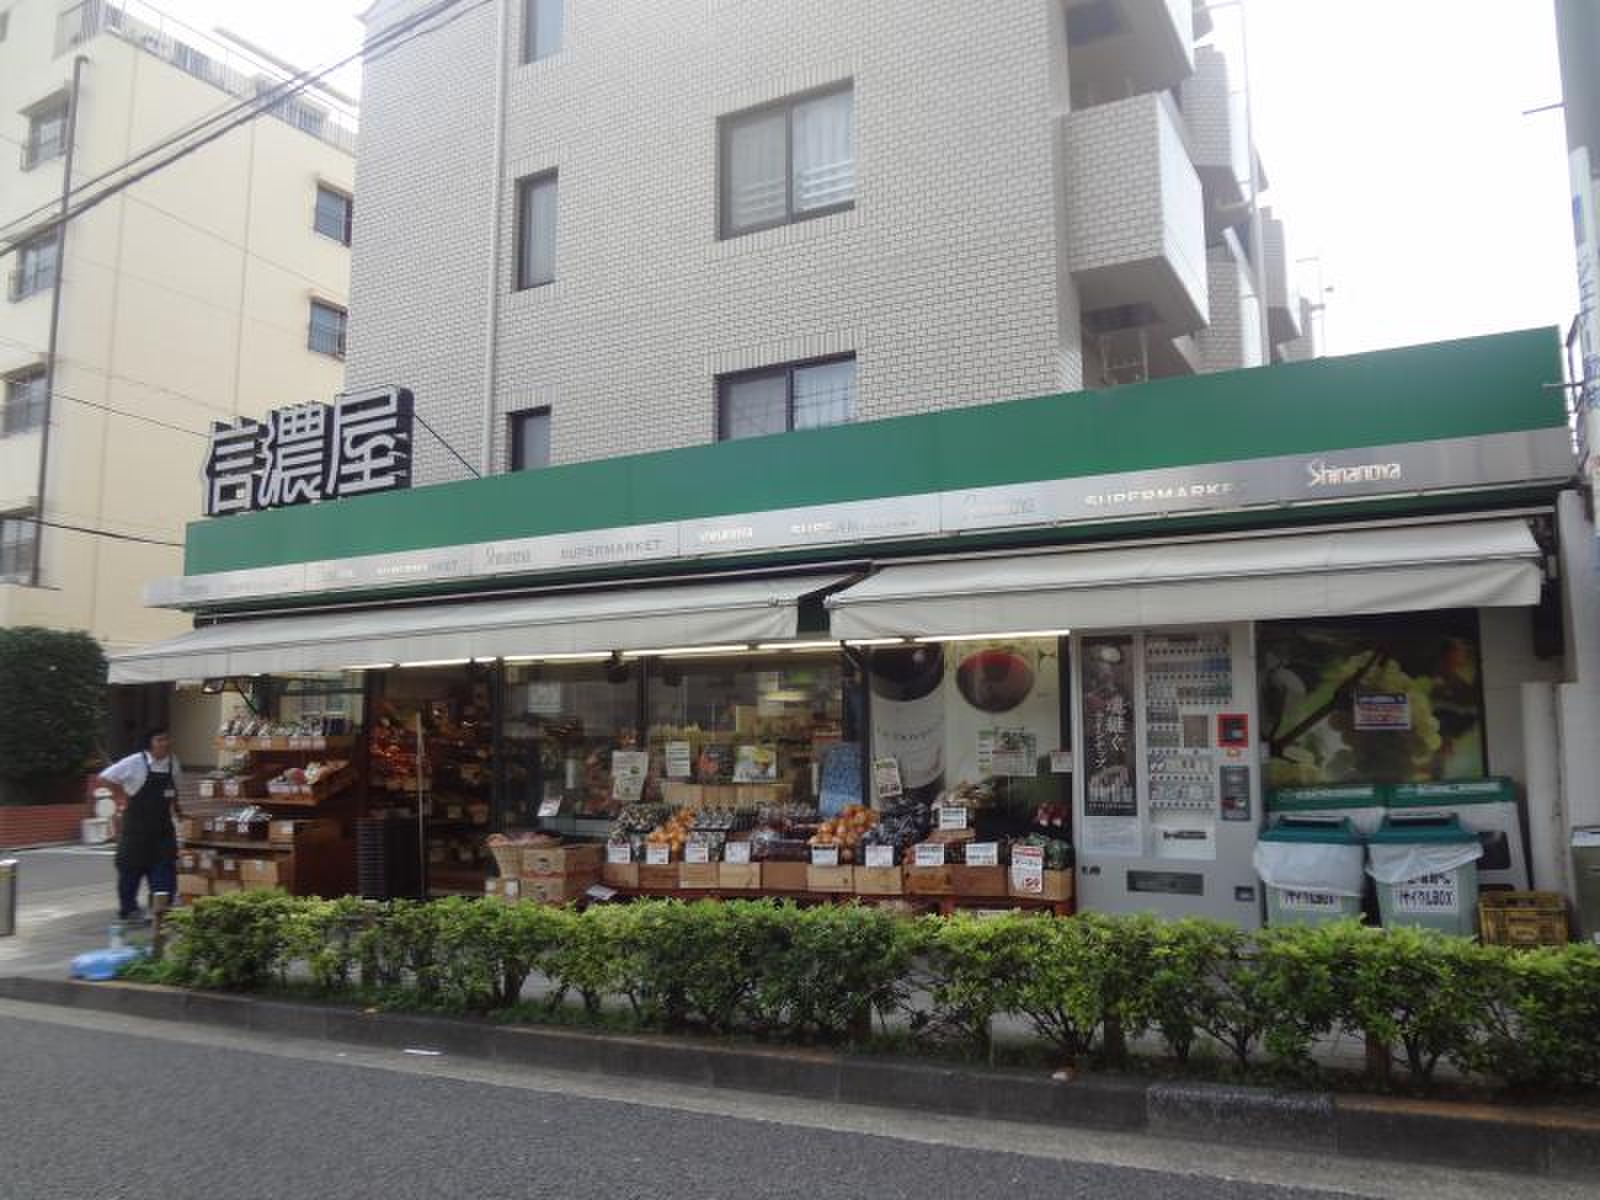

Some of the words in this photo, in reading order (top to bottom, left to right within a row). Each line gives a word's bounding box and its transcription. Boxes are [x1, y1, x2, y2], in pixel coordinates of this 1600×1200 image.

[203, 385, 411, 514] 信濃屋
[1307, 460, 1402, 488] Shinanoya
